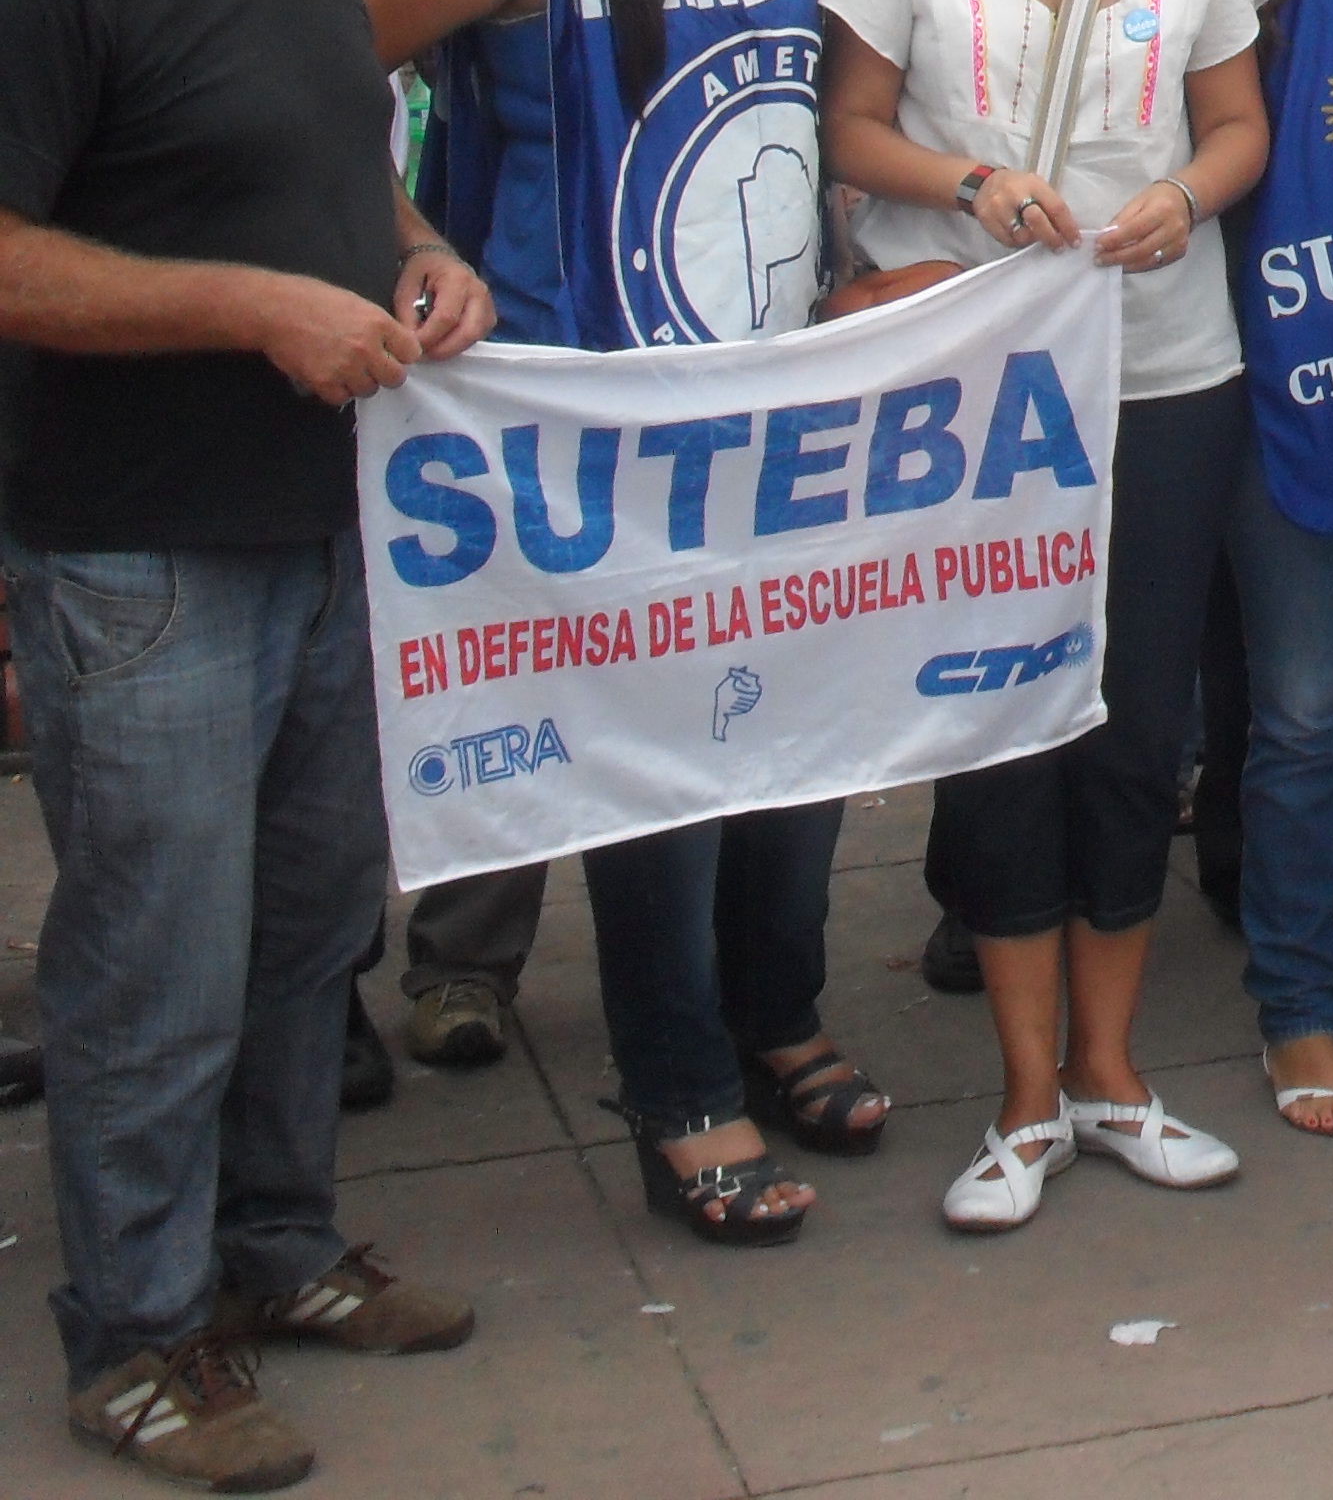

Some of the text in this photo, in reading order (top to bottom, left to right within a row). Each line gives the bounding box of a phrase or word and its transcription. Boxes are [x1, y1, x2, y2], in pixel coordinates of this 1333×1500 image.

[703, 46, 819, 108] AMET
[385, 349, 1098, 588] SUTEBA
[399, 527, 1096, 700] EN DEFENSA DE LA ESCUELA PUBLICA
